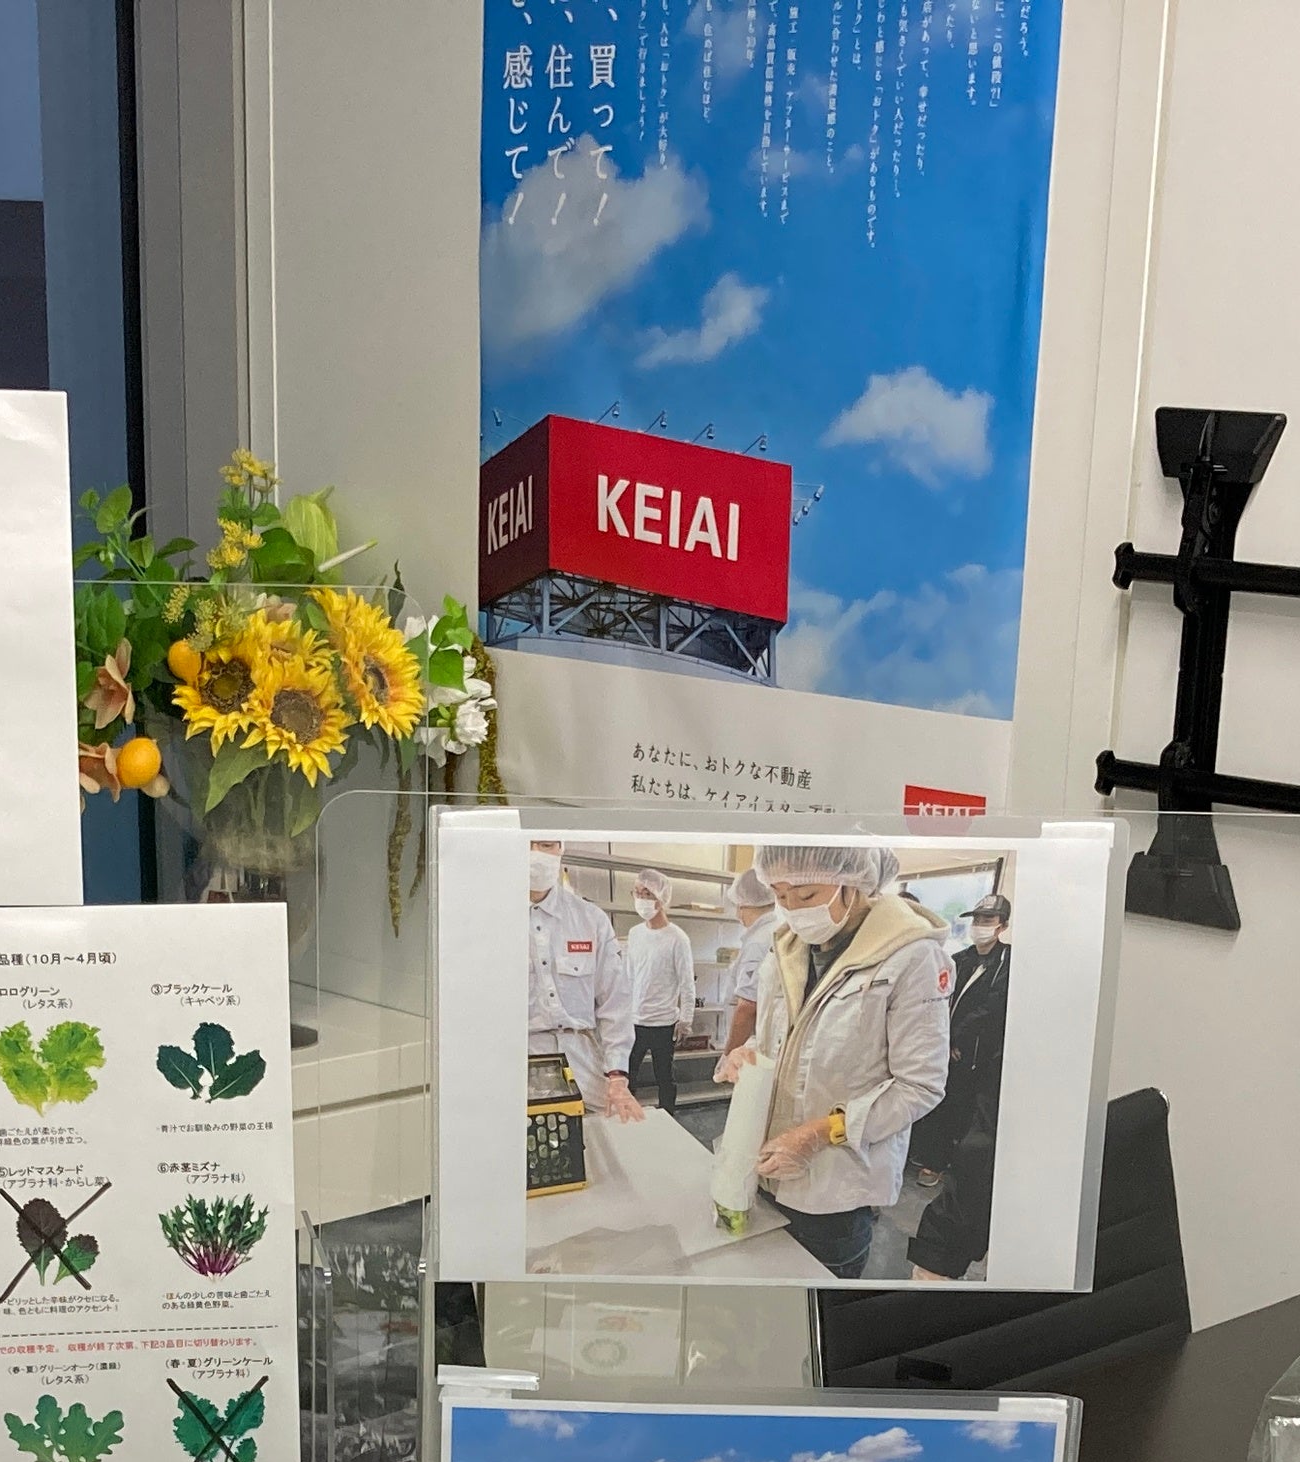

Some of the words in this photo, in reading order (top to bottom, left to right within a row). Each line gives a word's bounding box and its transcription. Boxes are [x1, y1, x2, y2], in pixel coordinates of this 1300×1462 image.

[502, 0, 534, 226] 、感じて！
[545, 0, 576, 226] 、住んで！
[588, 0, 618, 226] 、買って！
[486, 475, 534, 556] KEIAI
[596, 475, 740, 561] KEIAI
[631, 741, 813, 792] あなたに、おトクな不動産
